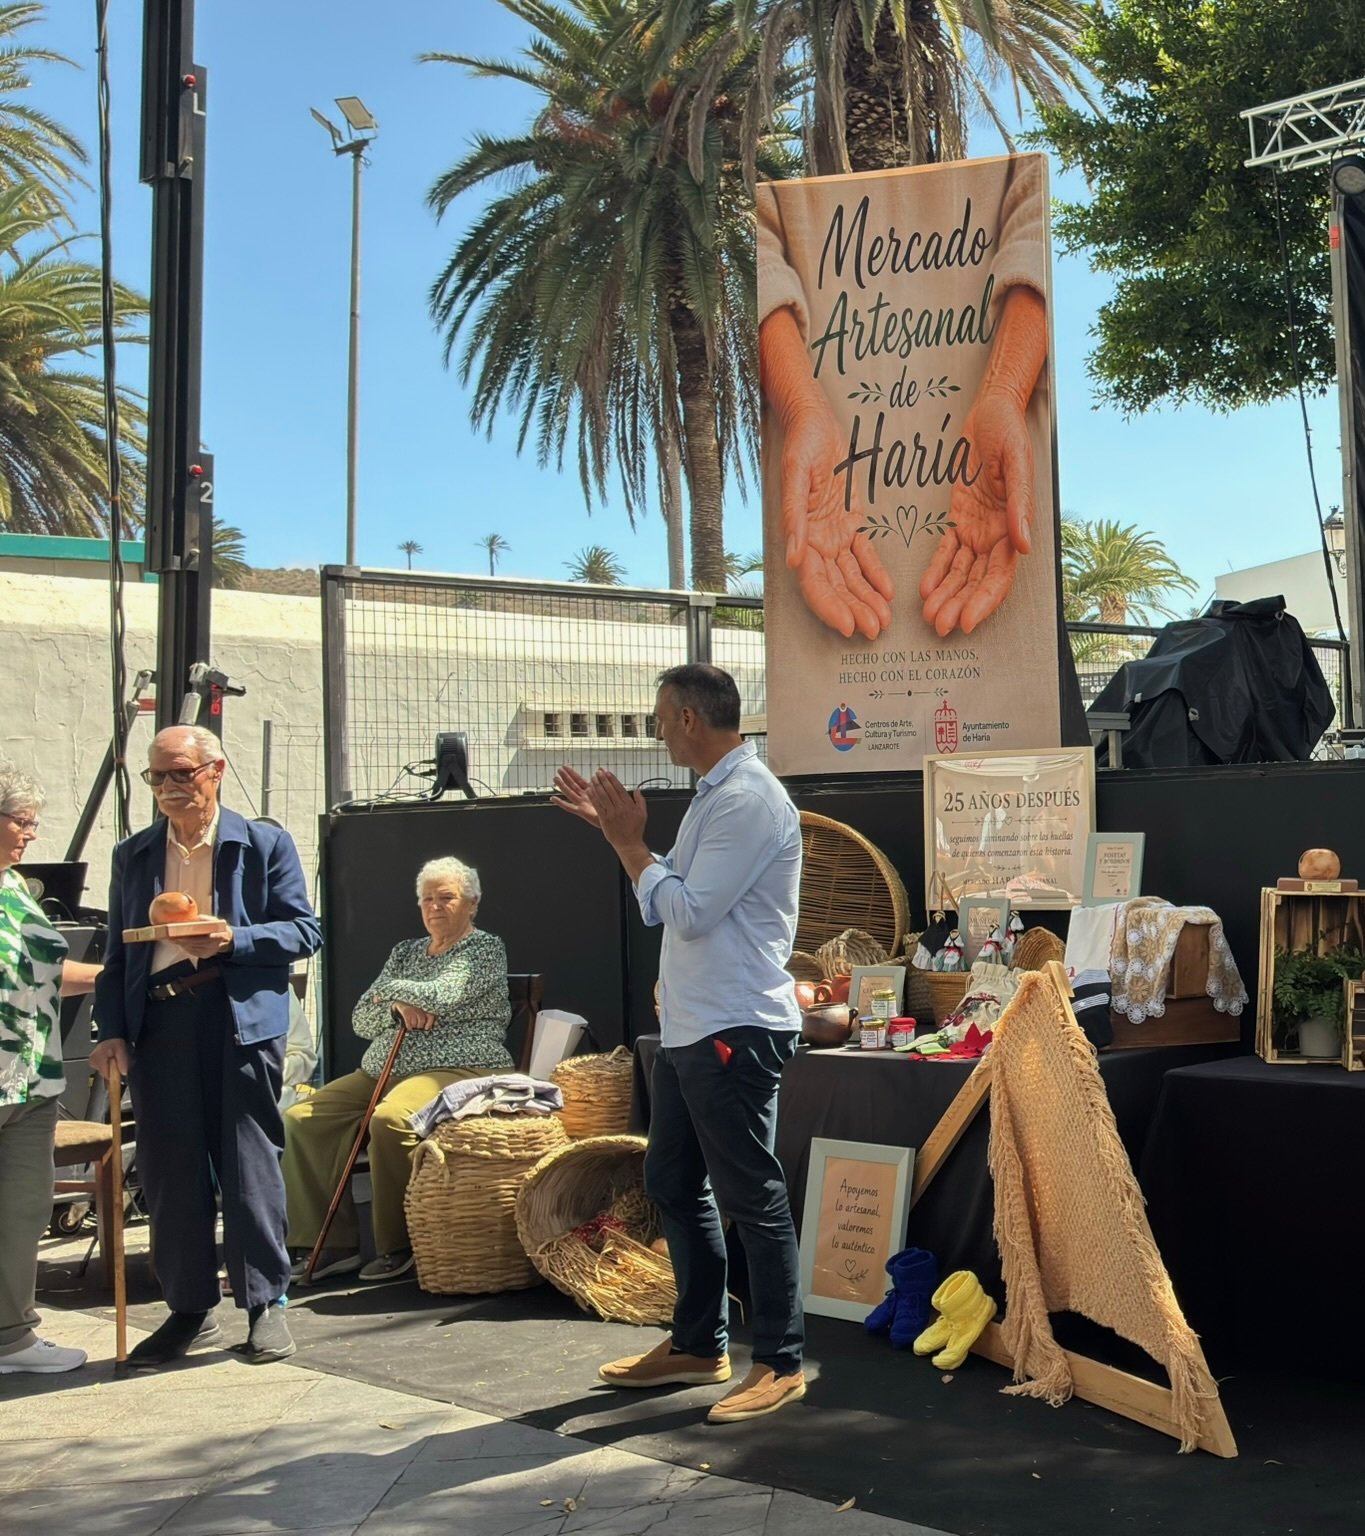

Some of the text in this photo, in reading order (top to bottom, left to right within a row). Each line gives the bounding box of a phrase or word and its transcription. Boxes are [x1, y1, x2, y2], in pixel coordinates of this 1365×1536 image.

[818, 195, 993, 290] Mercado
[810, 273, 997, 379] Artesanal
[889, 365, 921, 408] de
[833, 411, 983, 512] Haría
[200, 481, 213, 504] 2
[841, 648, 979, 665] HECHO CON LAS MANOS,
[839, 665, 981, 684] HECHO CON EL CORAZÓN
[865, 719, 914, 729] Centros de Arte,
[962, 721, 1010, 732] Ayuntamiento
[864, 729, 917, 739] Cultura y Turismo
[962, 732, 991, 742] de Haría
[868, 742, 900, 751] LANZAROTE
[943, 787, 1081, 812] 25 AÑOS DESPUÉS
[949, 833, 979, 845] seguimos
[1039, 831, 1048, 841] las
[1050, 831, 1074, 841] huellas
[951, 849, 960, 858] de
[840, 1178, 878, 1200] Apoyemos
[838, 1219, 873, 1235] valoremos
[832, 1235, 839, 1248] lo
